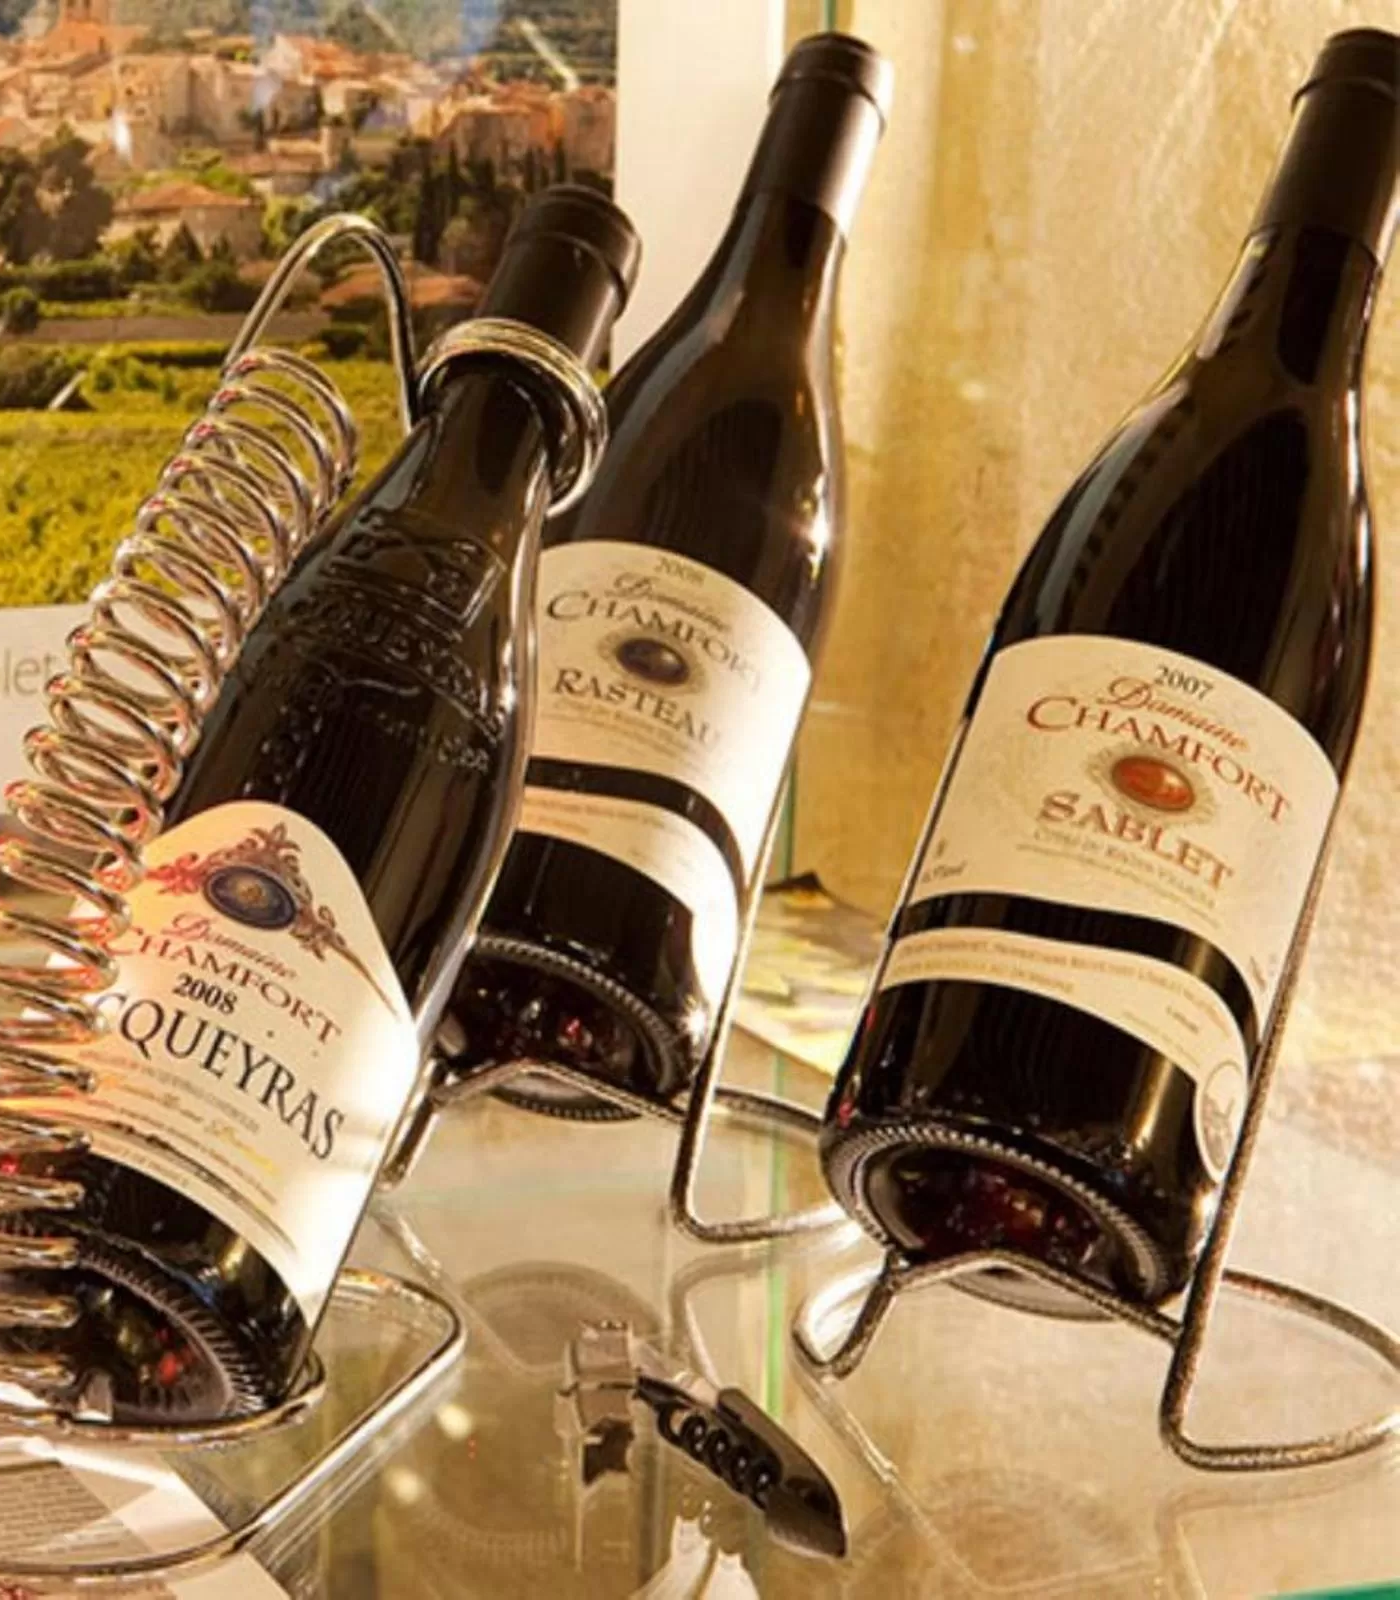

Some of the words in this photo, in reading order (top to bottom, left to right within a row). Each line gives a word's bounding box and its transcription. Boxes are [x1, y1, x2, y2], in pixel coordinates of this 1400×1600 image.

[553, 667, 721, 746] RASTEAU
[1097, 676, 1249, 750] Domaine
[1154, 665, 1216, 700] 2007
[1027, 695, 1291, 823] CHAMFORT
[1037, 790, 1235, 890] SABLET
[172, 972, 239, 1016] 2008
[93, 991, 345, 1160] QUEYRAS
